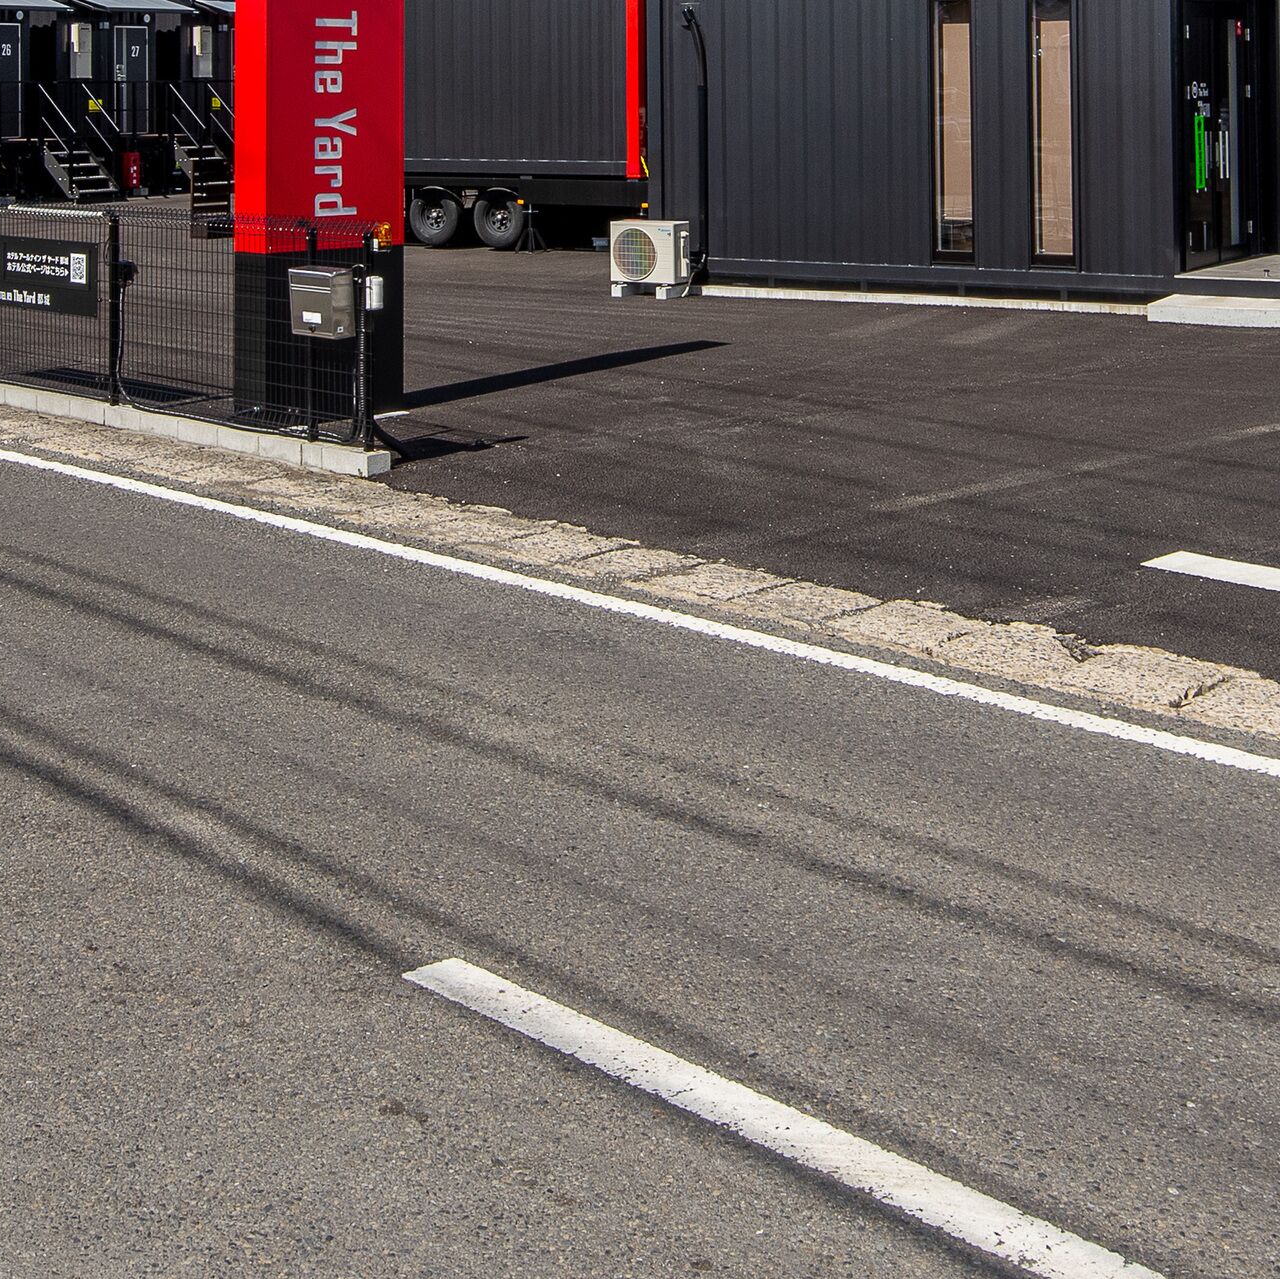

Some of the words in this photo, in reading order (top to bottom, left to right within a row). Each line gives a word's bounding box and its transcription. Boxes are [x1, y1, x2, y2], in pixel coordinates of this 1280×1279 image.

[1, 43, 12, 56] 26
[131, 45, 140, 58] 27
[314, 10, 358, 94] The
[314, 107, 358, 217] Yard
[7, 262, 65, 276] ホテル公式ページはこちら
[13, 289, 23, 303] The
[23, 290, 36, 304] Yard
